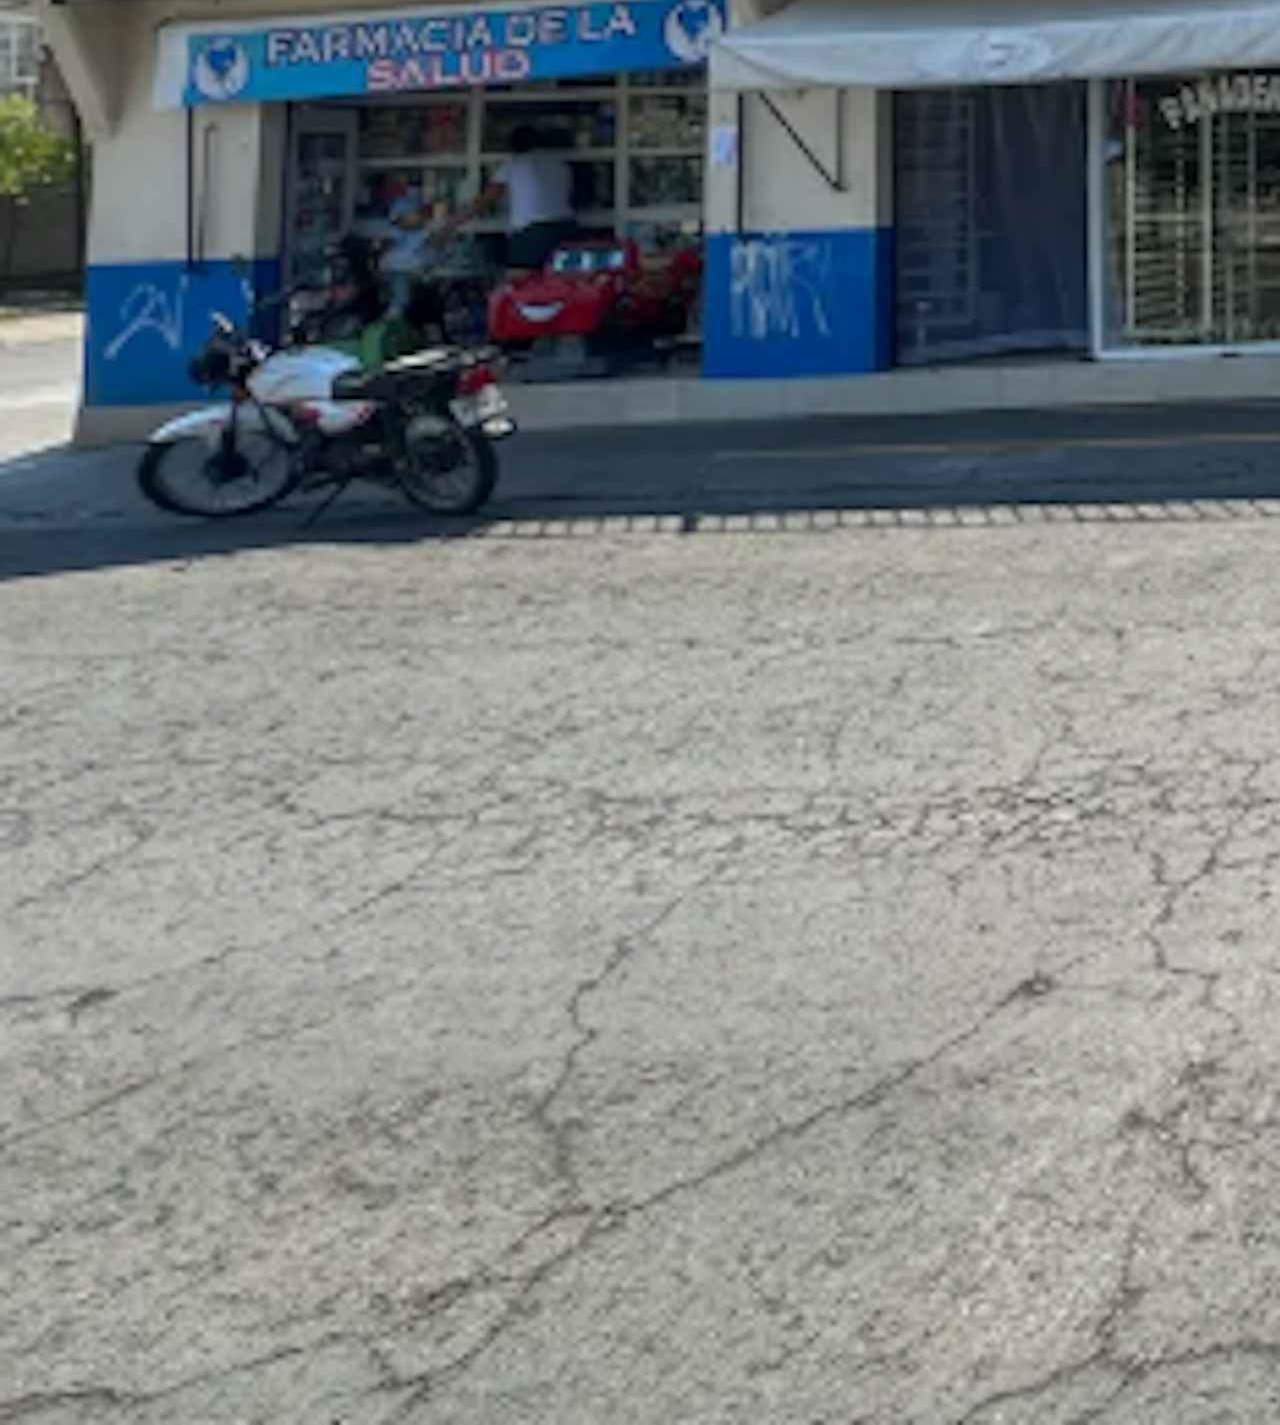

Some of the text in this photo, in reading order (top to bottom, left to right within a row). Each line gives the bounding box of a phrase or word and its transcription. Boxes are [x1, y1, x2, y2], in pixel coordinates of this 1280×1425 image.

[267, 5, 637, 65] FARMACIA DE LA
[366, 49, 532, 91] SALUD
